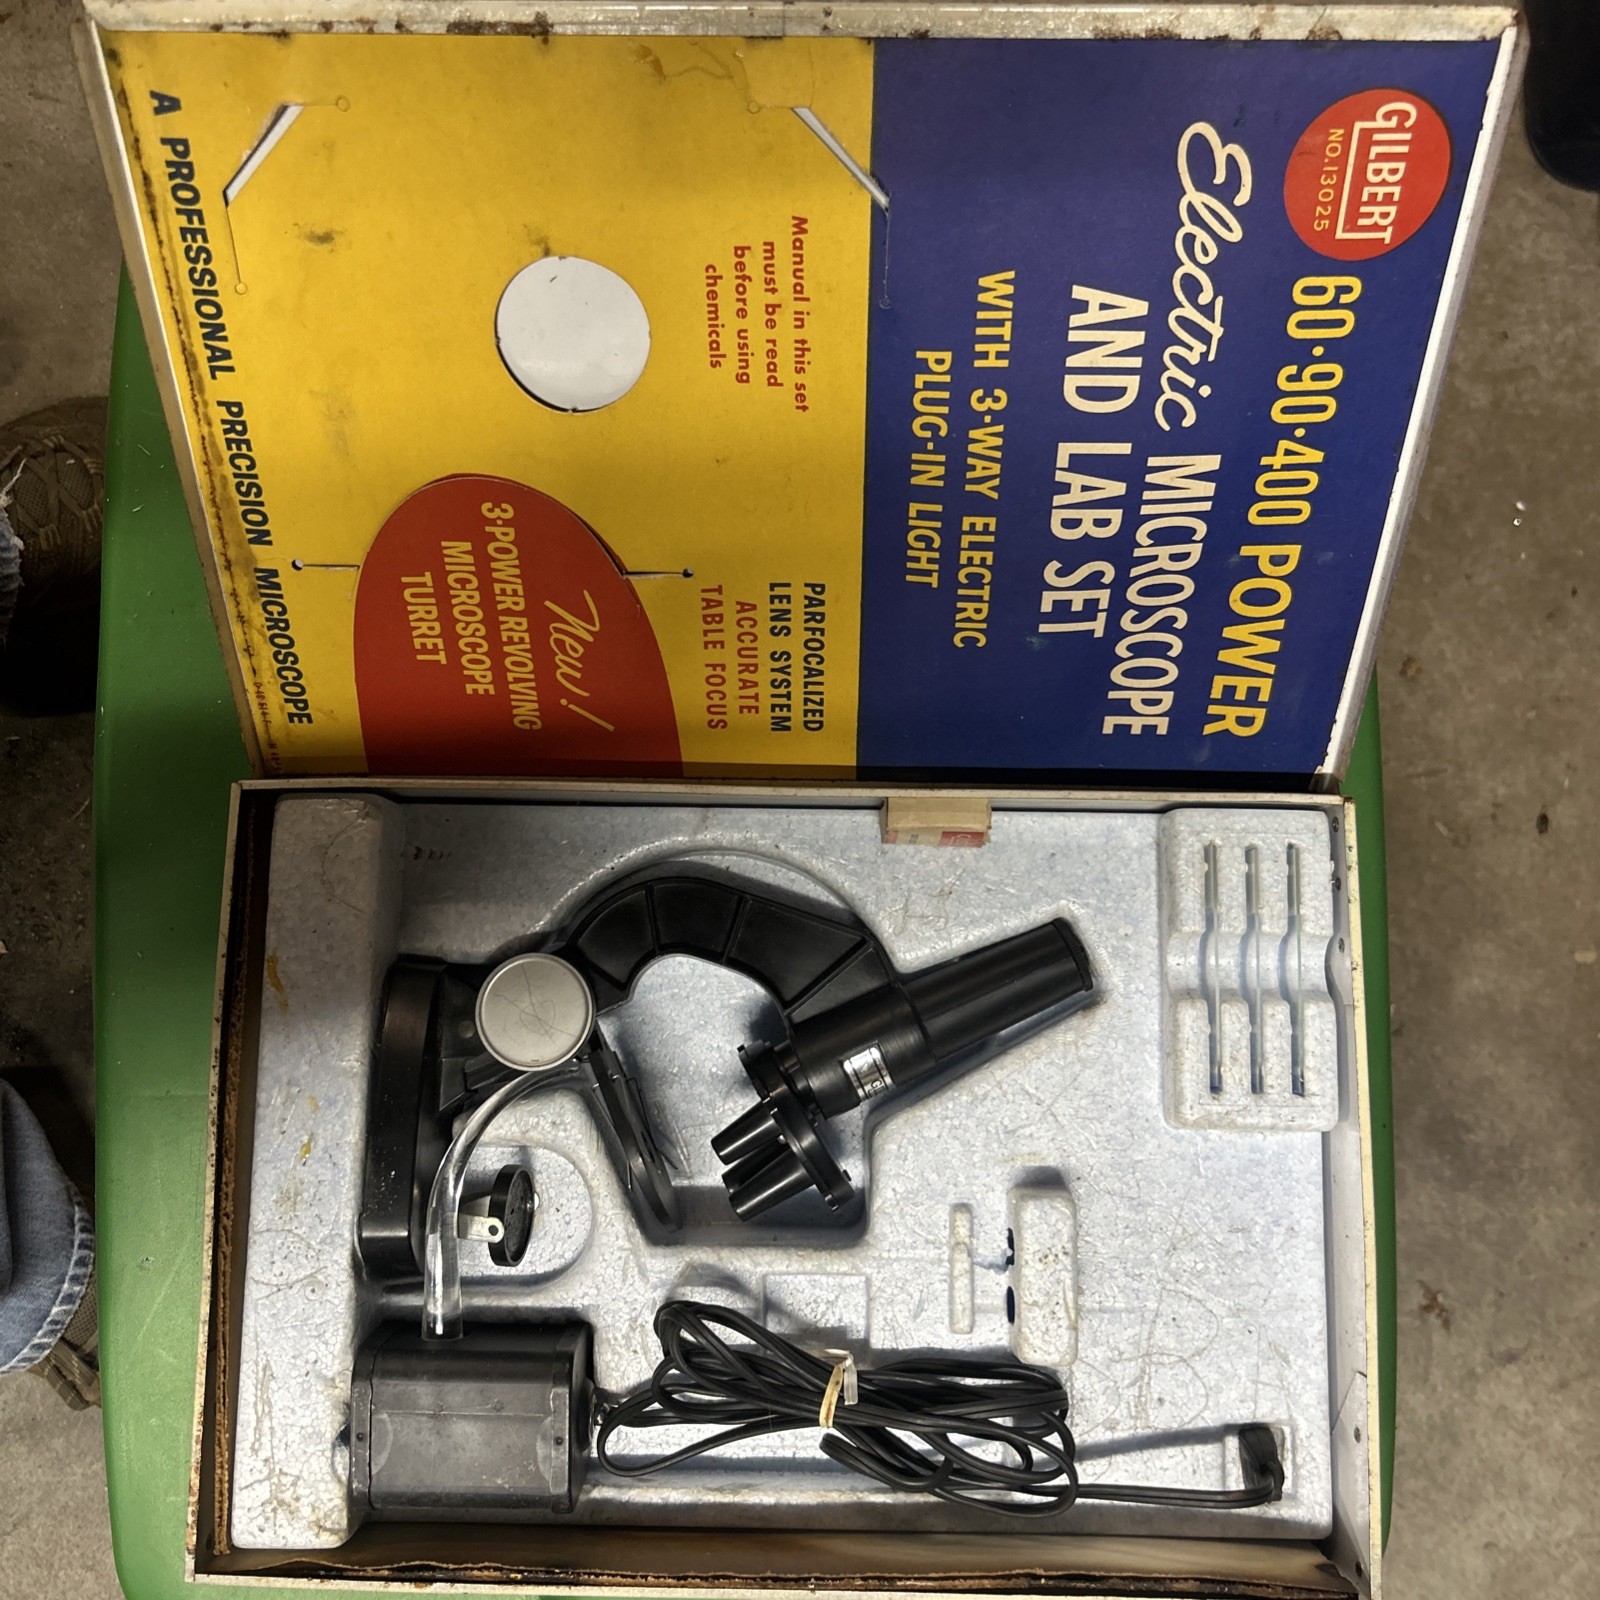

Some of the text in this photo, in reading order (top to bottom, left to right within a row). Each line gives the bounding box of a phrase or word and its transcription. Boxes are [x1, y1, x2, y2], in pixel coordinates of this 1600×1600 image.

[149, 91, 181, 116] A
[1335, 102, 1417, 244] GILBERT
[1314, 129, 1344, 231] NO.13025
[160, 136, 236, 381] PROFESSIONAL
[705, 264, 727, 369] chemicals
[734, 246, 754, 384] before using
[763, 242, 784, 387] must be read
[792, 215, 811, 412] Manual in this set
[974, 270, 1016, 369] WITH
[216, 400, 272, 547] PRECISION
[906, 349, 952, 588] PLUG-IN LIGHT
[1039, 286, 1149, 638] AND LAB SET
[1102, 121, 1252, 736] Electric MICROSCOPE
[254, 566, 313, 725] MICROSCOPE
[401, 572, 447, 665] TURRET
[441, 541, 495, 695] MICROSCOPE
[953, 516, 996, 648] ELECTRIC
[1202, 544, 1302, 737] POWER
[499, 616, 542, 730] REVOLVING
[701, 585, 728, 729] TABLE FOCUS
[736, 601, 759, 714] ACCURATE
[769, 582, 792, 731] LENS SYSTEM
[803, 583, 826, 732] PARFOCALIZED
